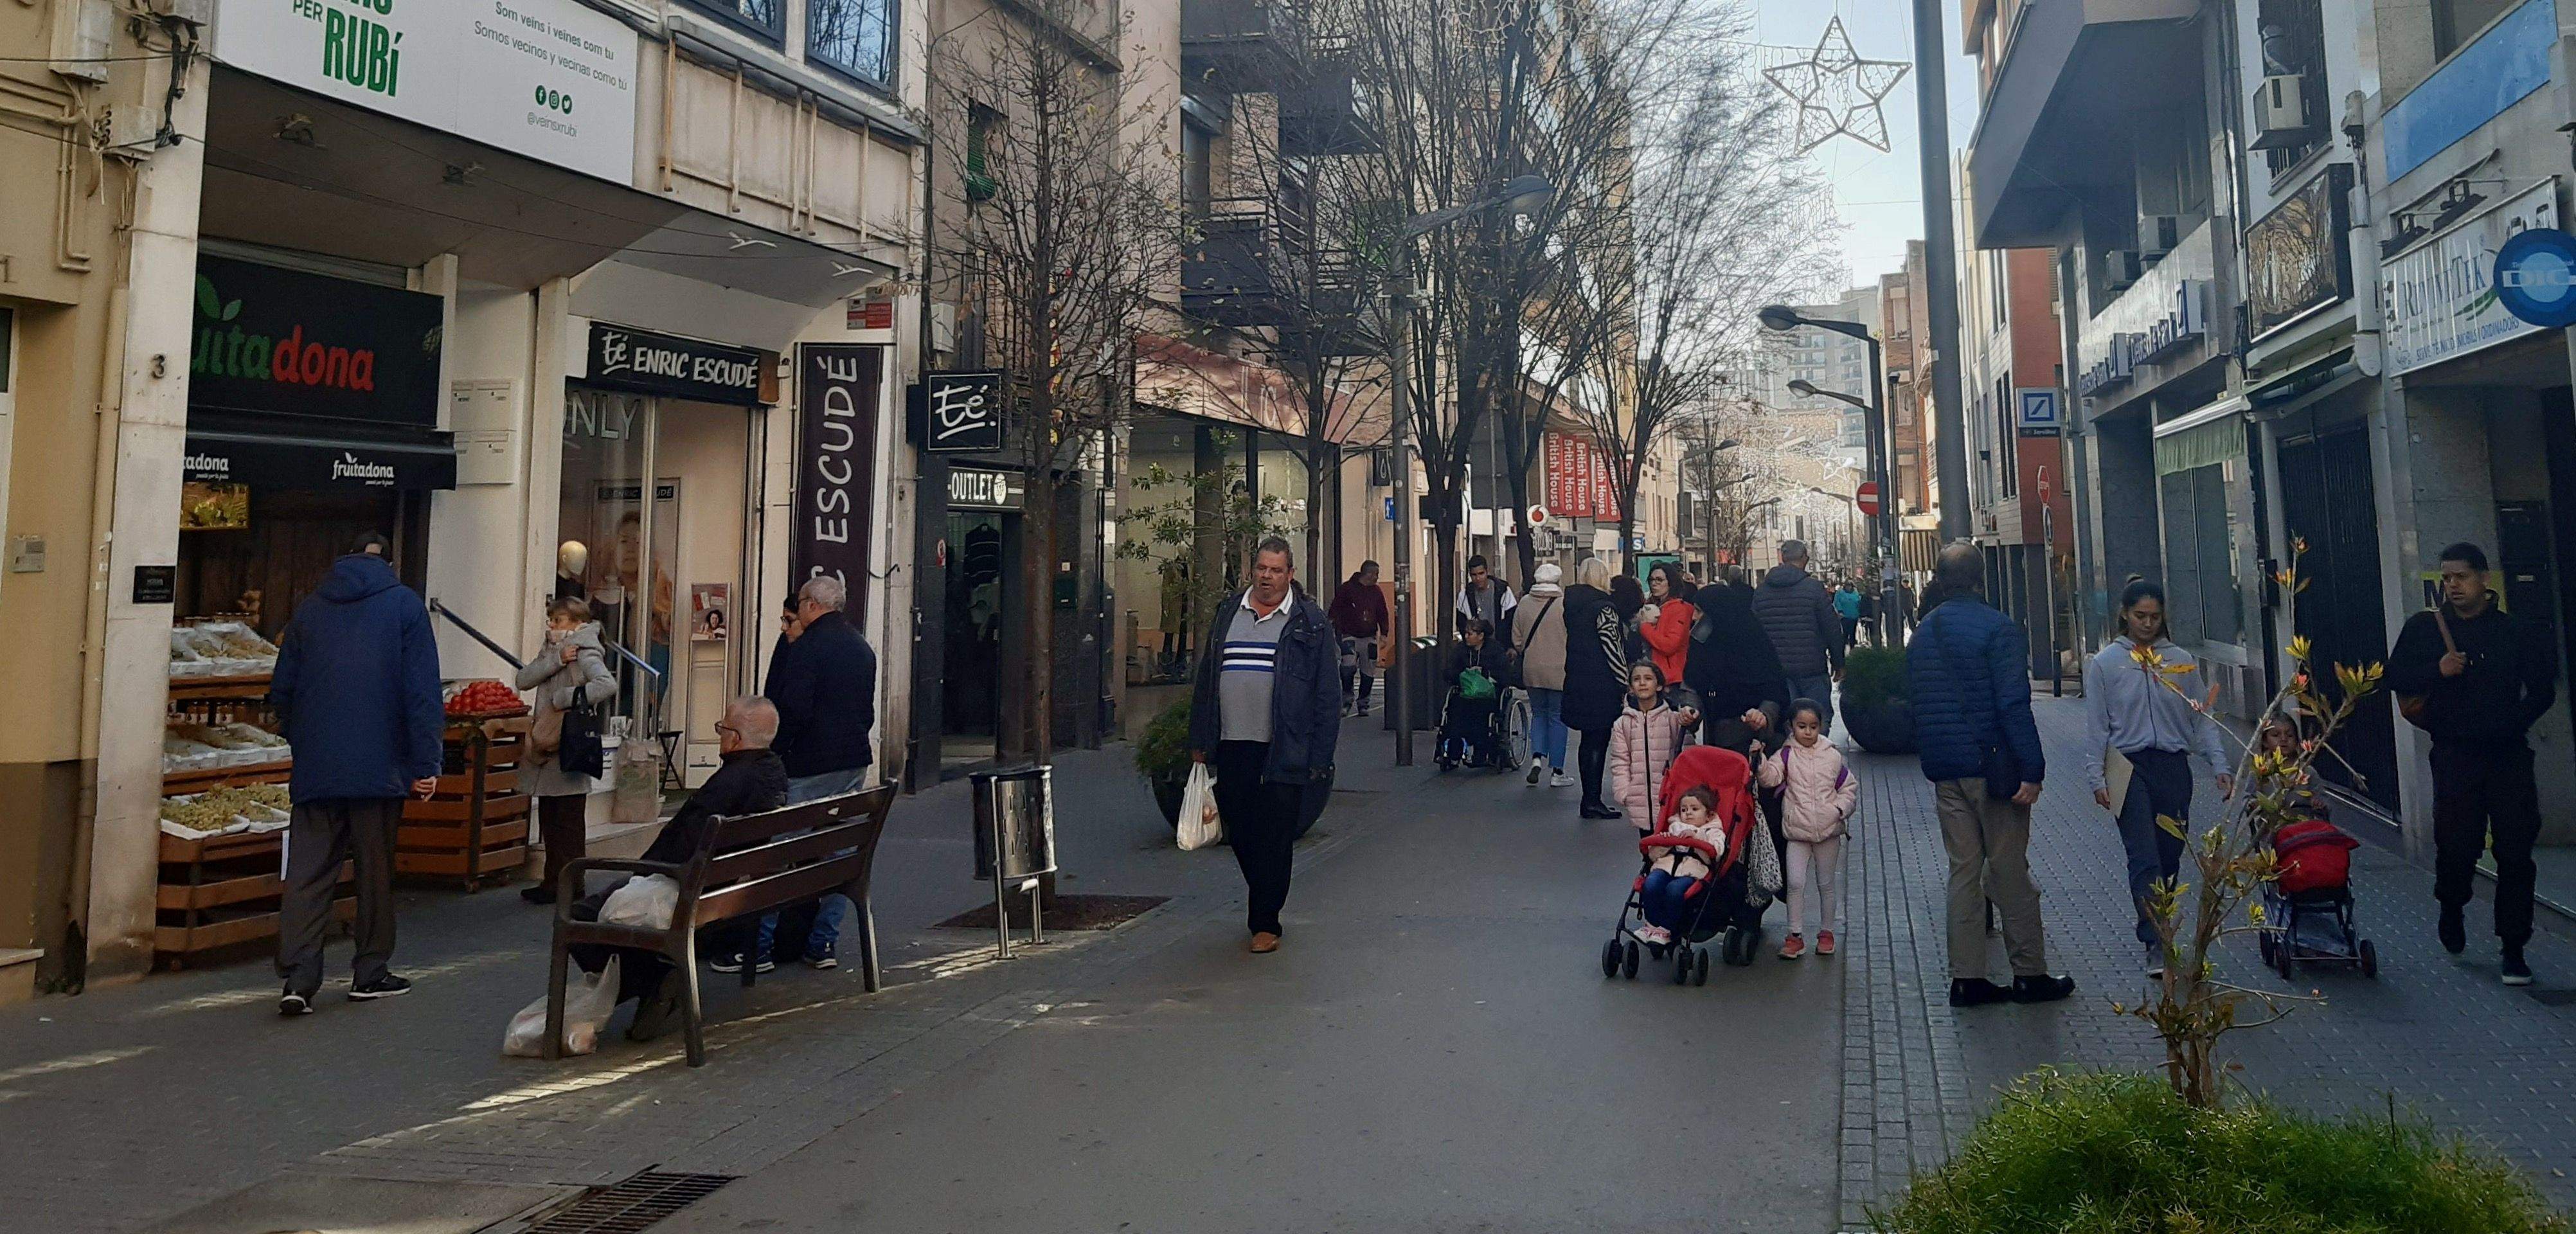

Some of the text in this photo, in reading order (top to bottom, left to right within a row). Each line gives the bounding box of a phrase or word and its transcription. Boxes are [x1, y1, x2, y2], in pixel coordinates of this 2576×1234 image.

[293, 0, 323, 22] PER
[496, 1, 517, 22] Som
[548, 22, 551, 35] i
[584, 40, 603, 56] com
[605, 47, 614, 60] tu
[474, 21, 510, 46] Somos
[512, 37, 548, 60] vecinos
[550, 52, 556, 66] y
[559, 55, 591, 76] vecinas
[593, 68, 616, 86] como
[150, 353, 165, 379] 3
[633, 346, 690, 379] ENRIC
[693, 357, 759, 388] ESCUDÉ
[563, 391, 641, 440] NLY
[332, 459, 395, 480] fruitadona
[815, 356, 857, 544] ESCUDÉ
[1549, 432, 1561, 508] British House
[951, 472, 994, 501] OUTLET
[1564, 439, 1575, 511] British House
[1576, 442, 1588, 511] British House
[1598, 485, 1607, 515] House
